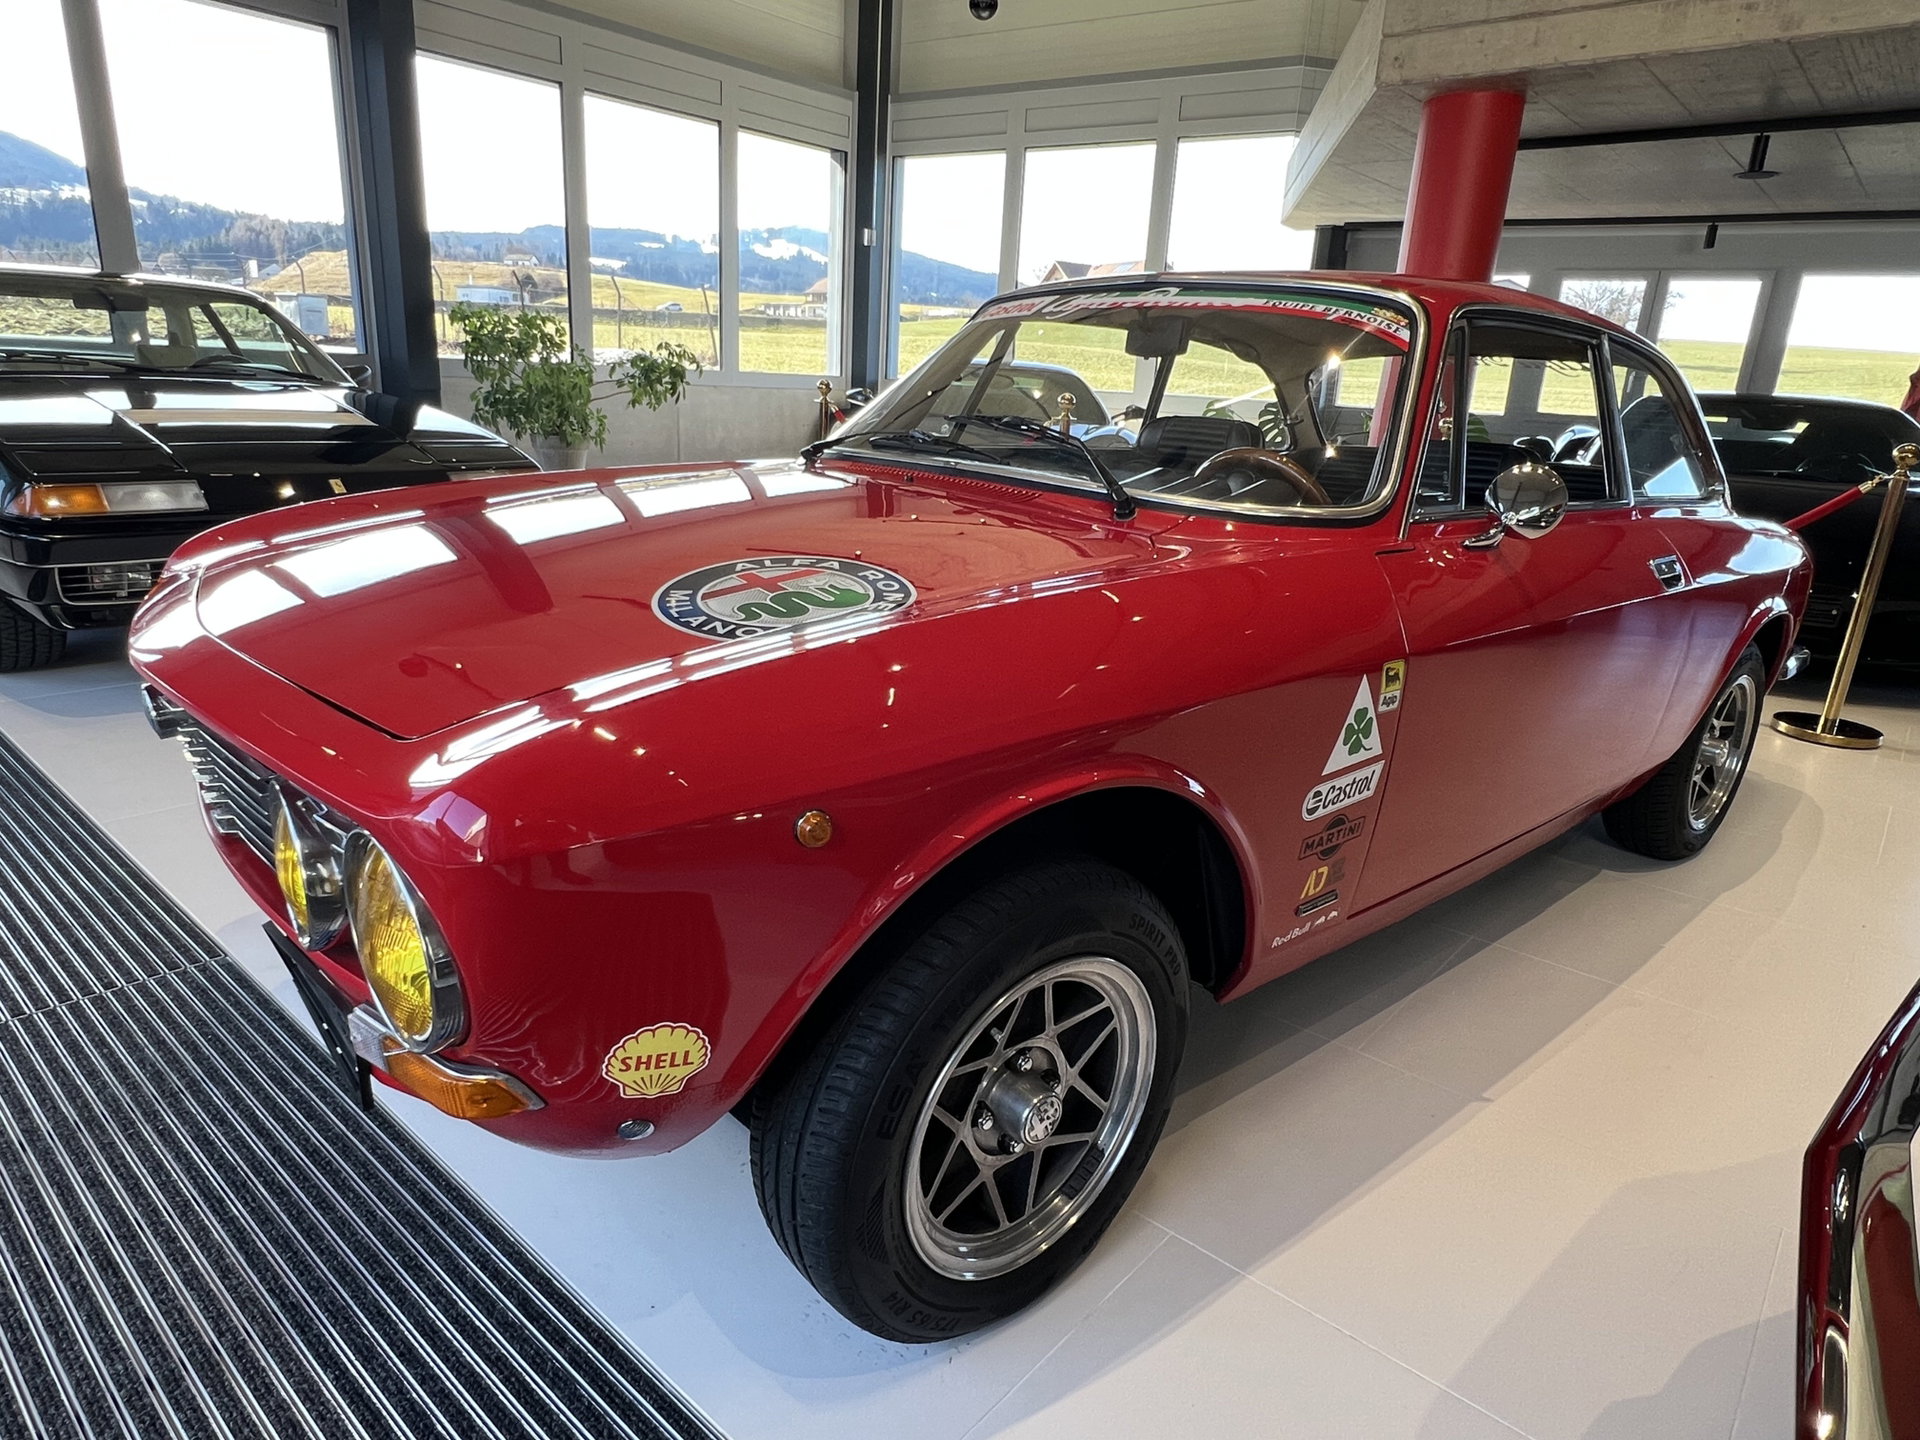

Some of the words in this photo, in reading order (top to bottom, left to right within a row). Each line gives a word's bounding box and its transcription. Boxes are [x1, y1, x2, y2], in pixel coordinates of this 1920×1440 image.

[1263, 299, 1320, 311] EQUIPE
[1322, 306, 1405, 335] BERNOISE
[734, 558, 841, 572] ALFA
[850, 570, 905, 615] ROME
[665, 590, 765, 637] MILANO
[1381, 693, 1398, 707] Agip
[1322, 769, 1376, 810] Castrol
[1303, 821, 1361, 855] MARTINI
[1129, 913, 1165, 948] SPIRIT
[1165, 945, 1181, 976] PRO
[618, 1049, 695, 1073] SHELL
